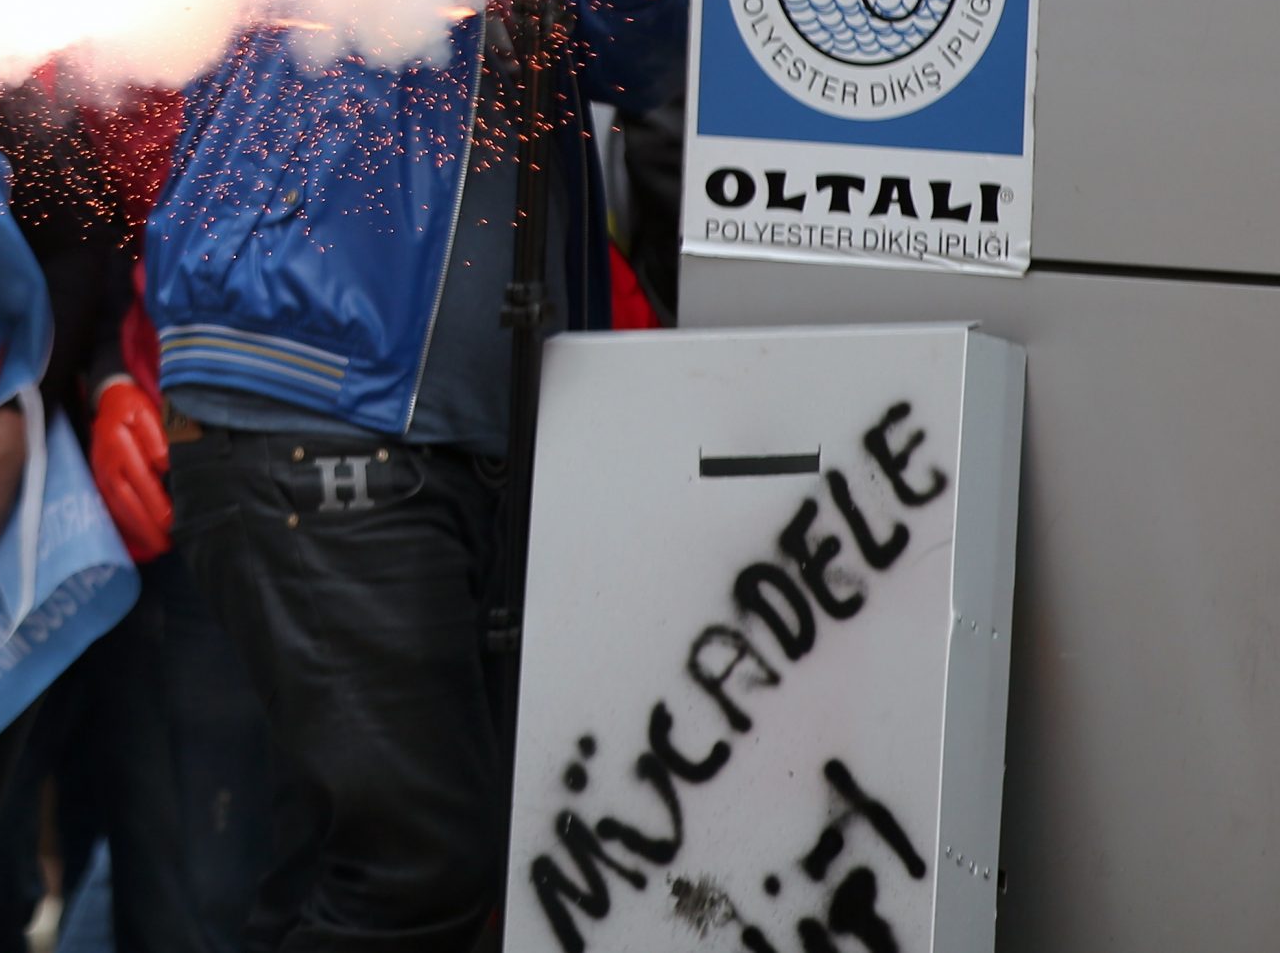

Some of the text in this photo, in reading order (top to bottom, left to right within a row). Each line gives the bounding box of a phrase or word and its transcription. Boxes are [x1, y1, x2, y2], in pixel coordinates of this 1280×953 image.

[871, 62, 941, 106] DİKİŞ
[705, 167, 1001, 223] OLTALI
[705, 219, 1009, 261] POLYESTER DİKİŞ İPLİĞİ
[314, 456, 375, 511] H
[529, 400, 948, 953] MÜCADELE
